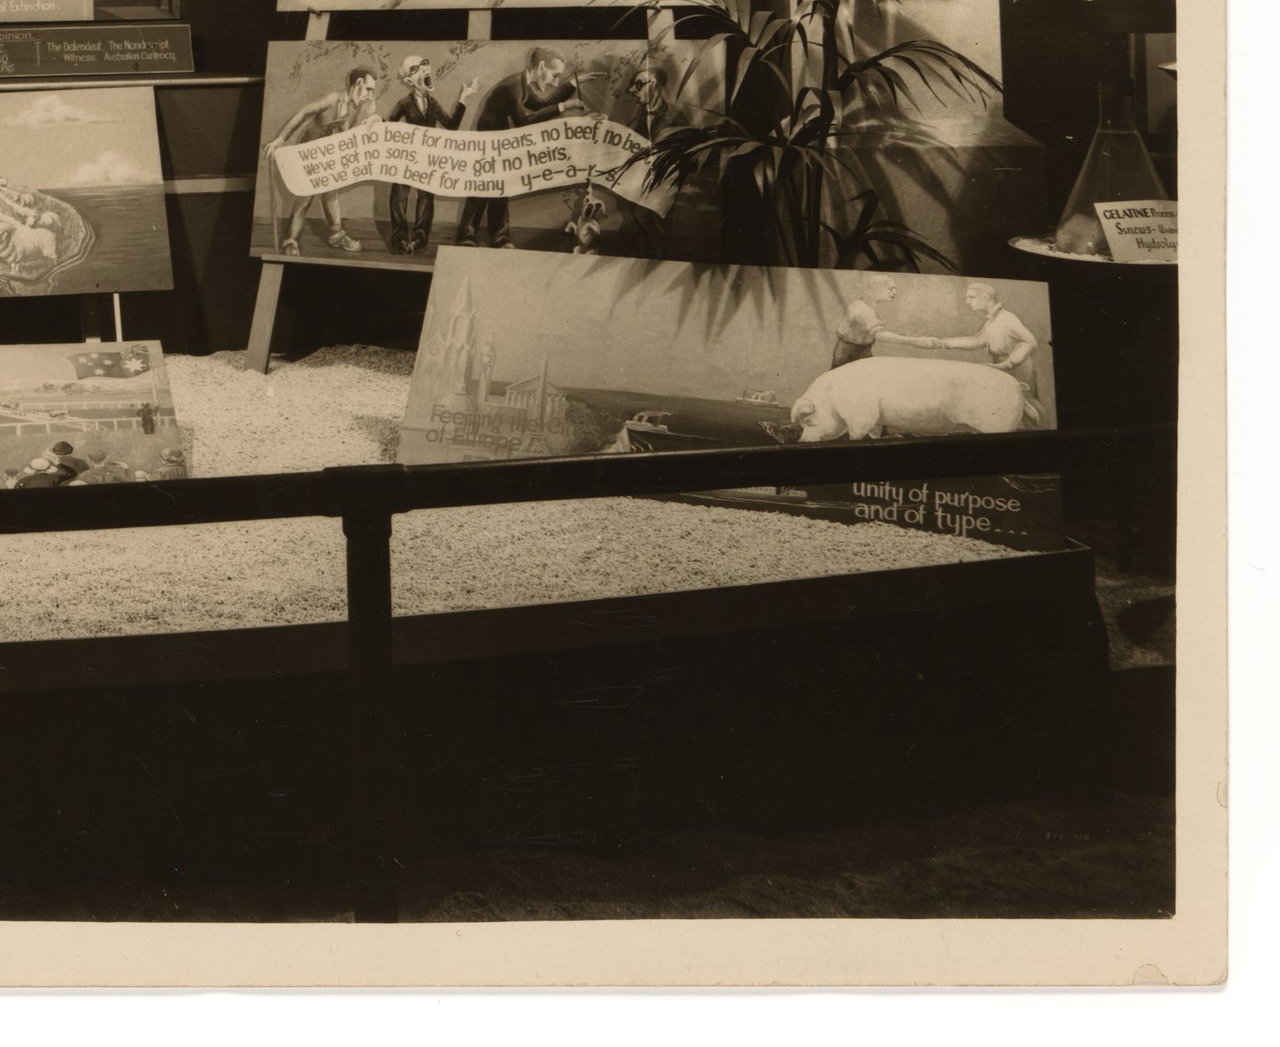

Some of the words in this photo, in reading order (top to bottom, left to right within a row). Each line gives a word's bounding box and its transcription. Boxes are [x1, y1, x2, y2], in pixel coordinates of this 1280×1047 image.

[47, 42, 62, 51] The
[108, 40, 122, 50] The
[104, 51, 140, 62] Australian
[338, 135, 360, 155] eat
[361, 130, 379, 146] no
[382, 125, 418, 146] beef
[421, 127, 442, 148] for
[443, 136, 487, 158] many
[540, 126, 561, 143] no
[563, 121, 603, 146] beef,
[602, 128, 623, 147] no
[339, 150, 361, 172] got
[362, 147, 381, 163] no
[384, 145, 419, 164] sons,
[472, 154, 496, 178] got
[502, 155, 523, 173] no
[527, 144, 572, 168] heirs,
[351, 160, 374, 179] eat
[379, 162, 398, 178] no
[402, 162, 437, 187] beef
[438, 166, 461, 191] for
[462, 177, 505, 197] many
[1103, 208, 1151, 220] GELATINE
[1135, 236, 1177, 253] Hydroly
[425, 425, 446, 444] of
[852, 480, 904, 505] unity
[908, 482, 930, 503] of
[934, 489, 1022, 515] purpose
[854, 502, 898, 521] and
[904, 504, 927, 525] of
